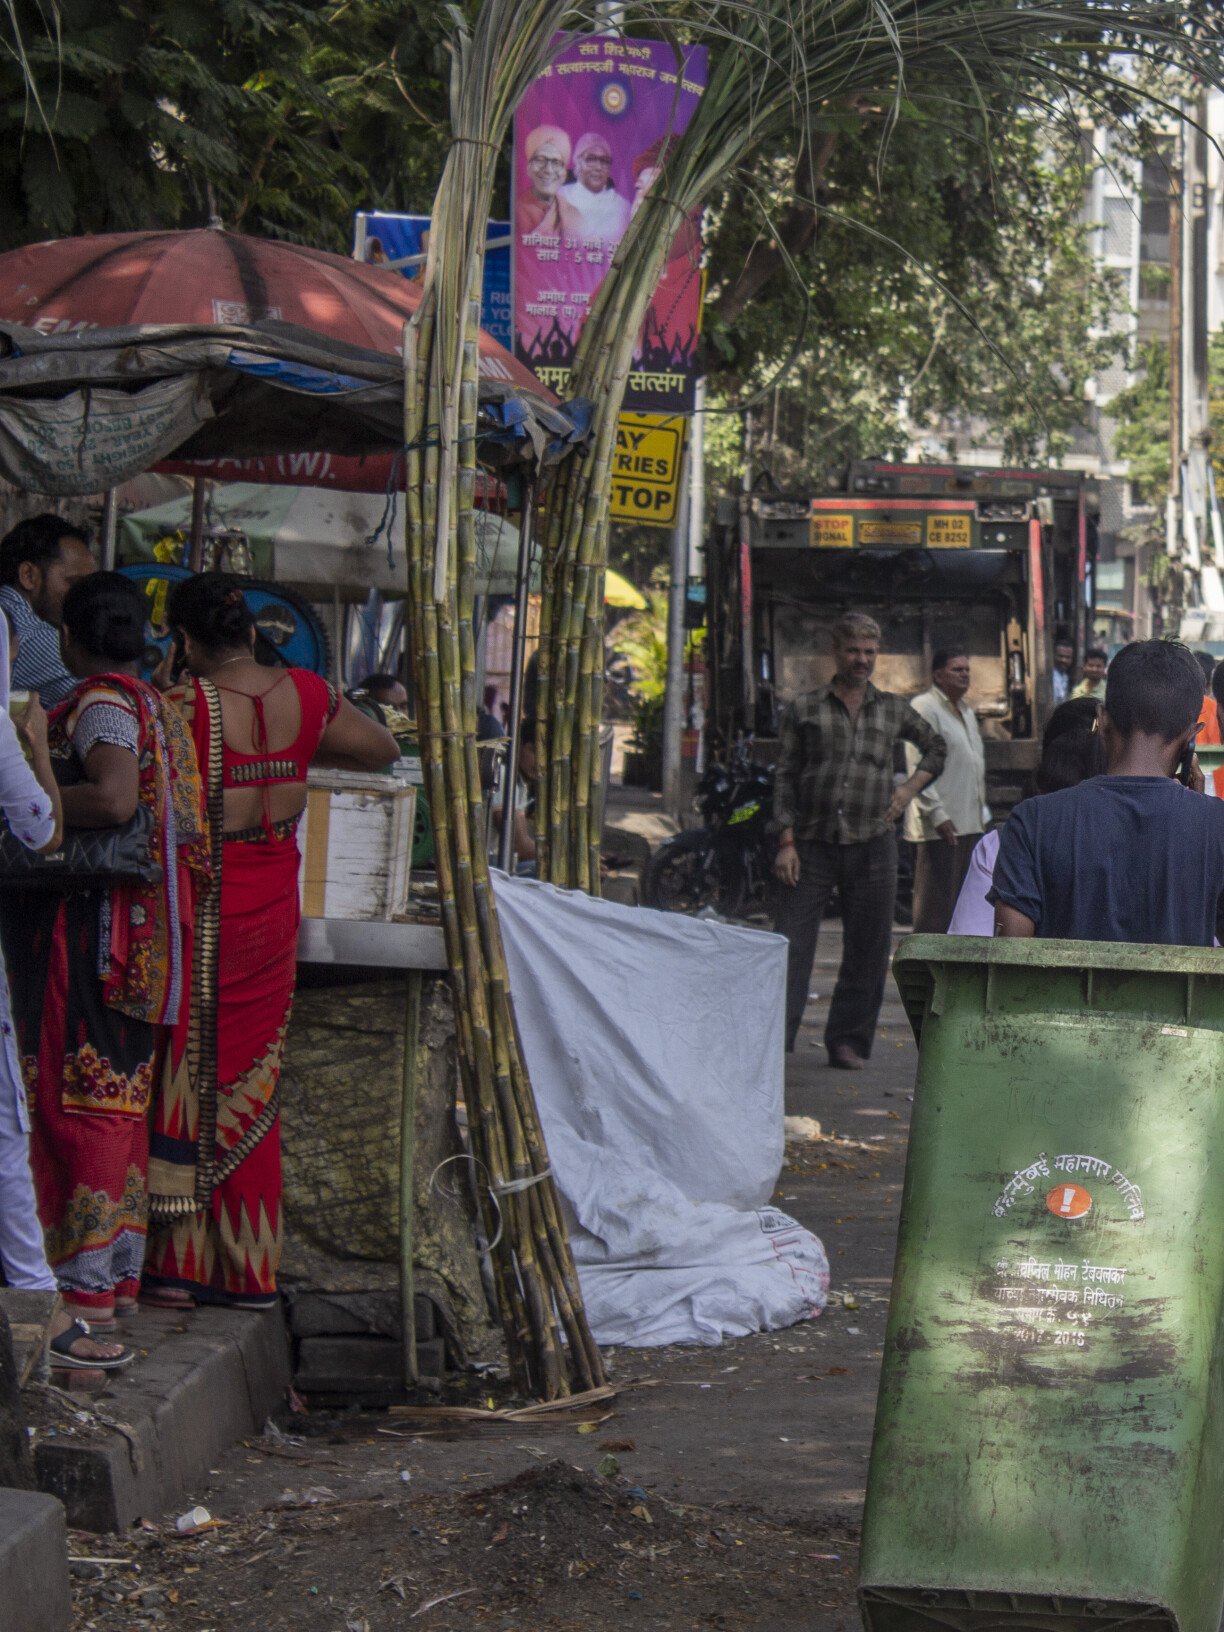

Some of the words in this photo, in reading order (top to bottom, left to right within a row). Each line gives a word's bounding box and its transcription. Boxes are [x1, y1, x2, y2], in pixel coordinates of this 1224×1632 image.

[579, 42, 599, 56] संत
[603, 42, 651, 60] शिरमणी
[618, 62, 656, 80] महाराज
[522, 232, 561, 249] शनिवार
[574, 252, 582, 264] 5
[526, 302, 558, 317] मालाड
[629, 367, 686, 393] सत्संग
[616, 431, 645, 451] AY
[613, 453, 669, 477] RIES
[814, 519, 849, 530] STOP
[933, 519, 949, 530] MH
[952, 519, 964, 530] 02
[813, 531, 848, 542] SIGNAL
[1054, 1154, 1112, 1181] महानगर
[1111, 1169, 1146, 1224] पालिक
[1054, 1258, 1079, 1281] मोहन
[1054, 1330, 1086, 1347] 2018
